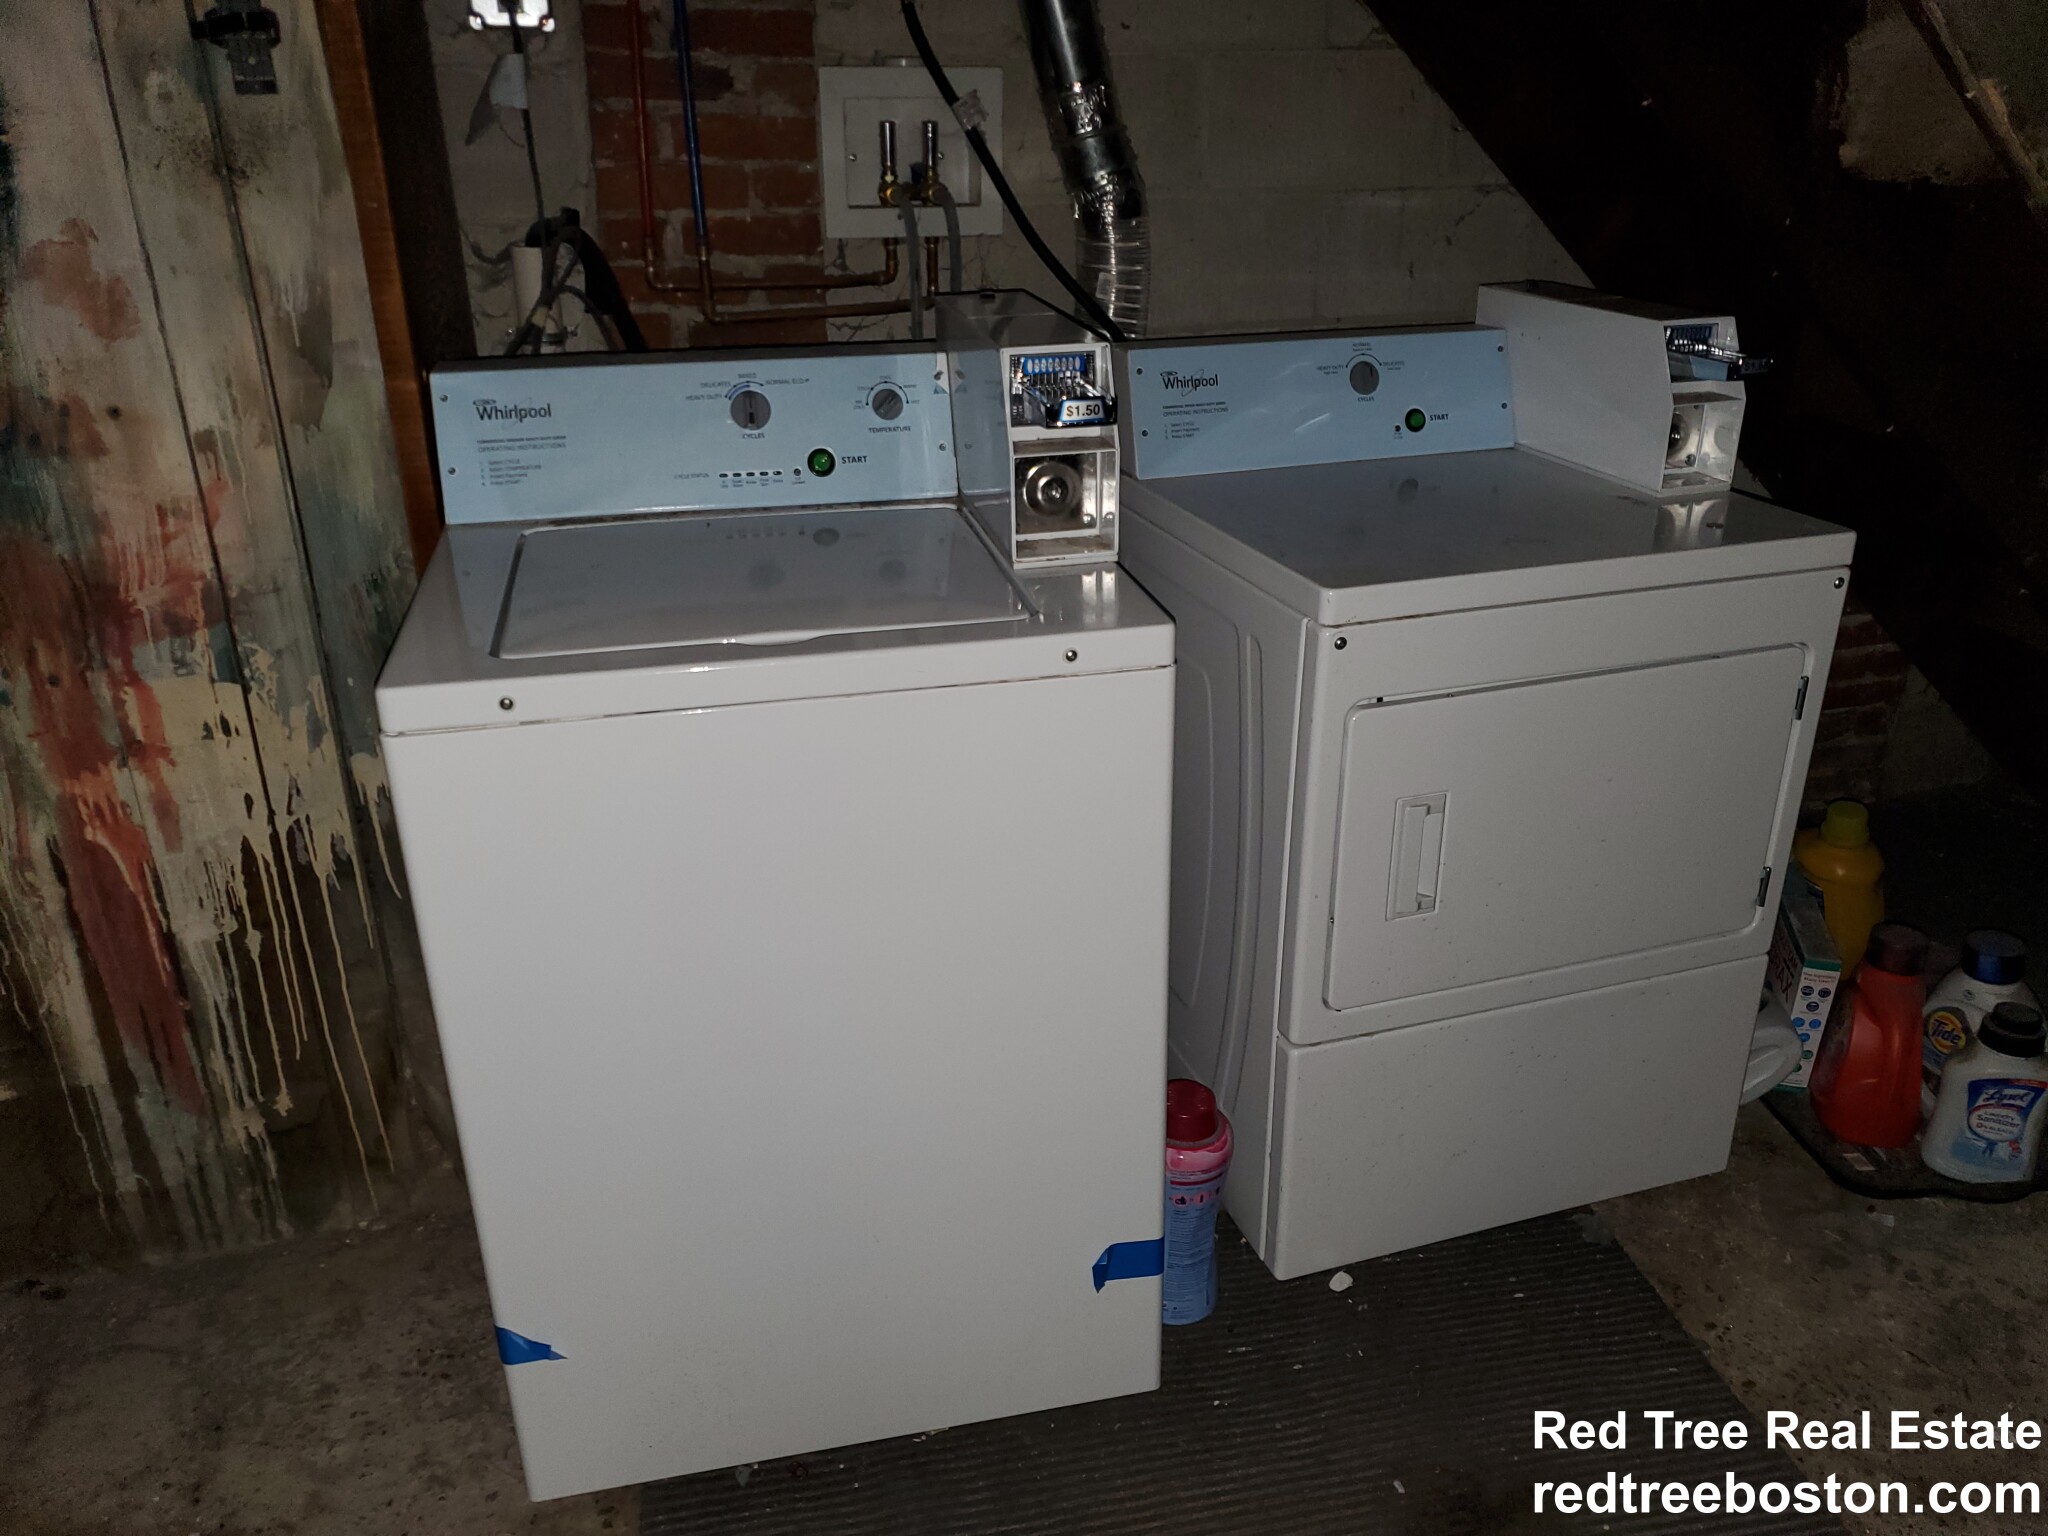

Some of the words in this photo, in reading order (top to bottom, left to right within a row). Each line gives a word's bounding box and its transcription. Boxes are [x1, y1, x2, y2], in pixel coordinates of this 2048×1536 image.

[1162, 373, 1218, 391] Whirlpool
[476, 403, 552, 423] Whirlpool
[1066, 404, 1101, 417] $1.50
[1193, 407, 1229, 415] INSTRUCTIONS
[1430, 413, 1449, 421] START
[742, 432, 766, 440] CYCLES
[841, 455, 868, 465] START
[1931, 1018, 1963, 1046] Tide
[1983, 1088, 2032, 1104] Lysol
[1977, 1114, 2021, 1129] Sanitizer
[1984, 1111, 2016, 1122] Laundry
